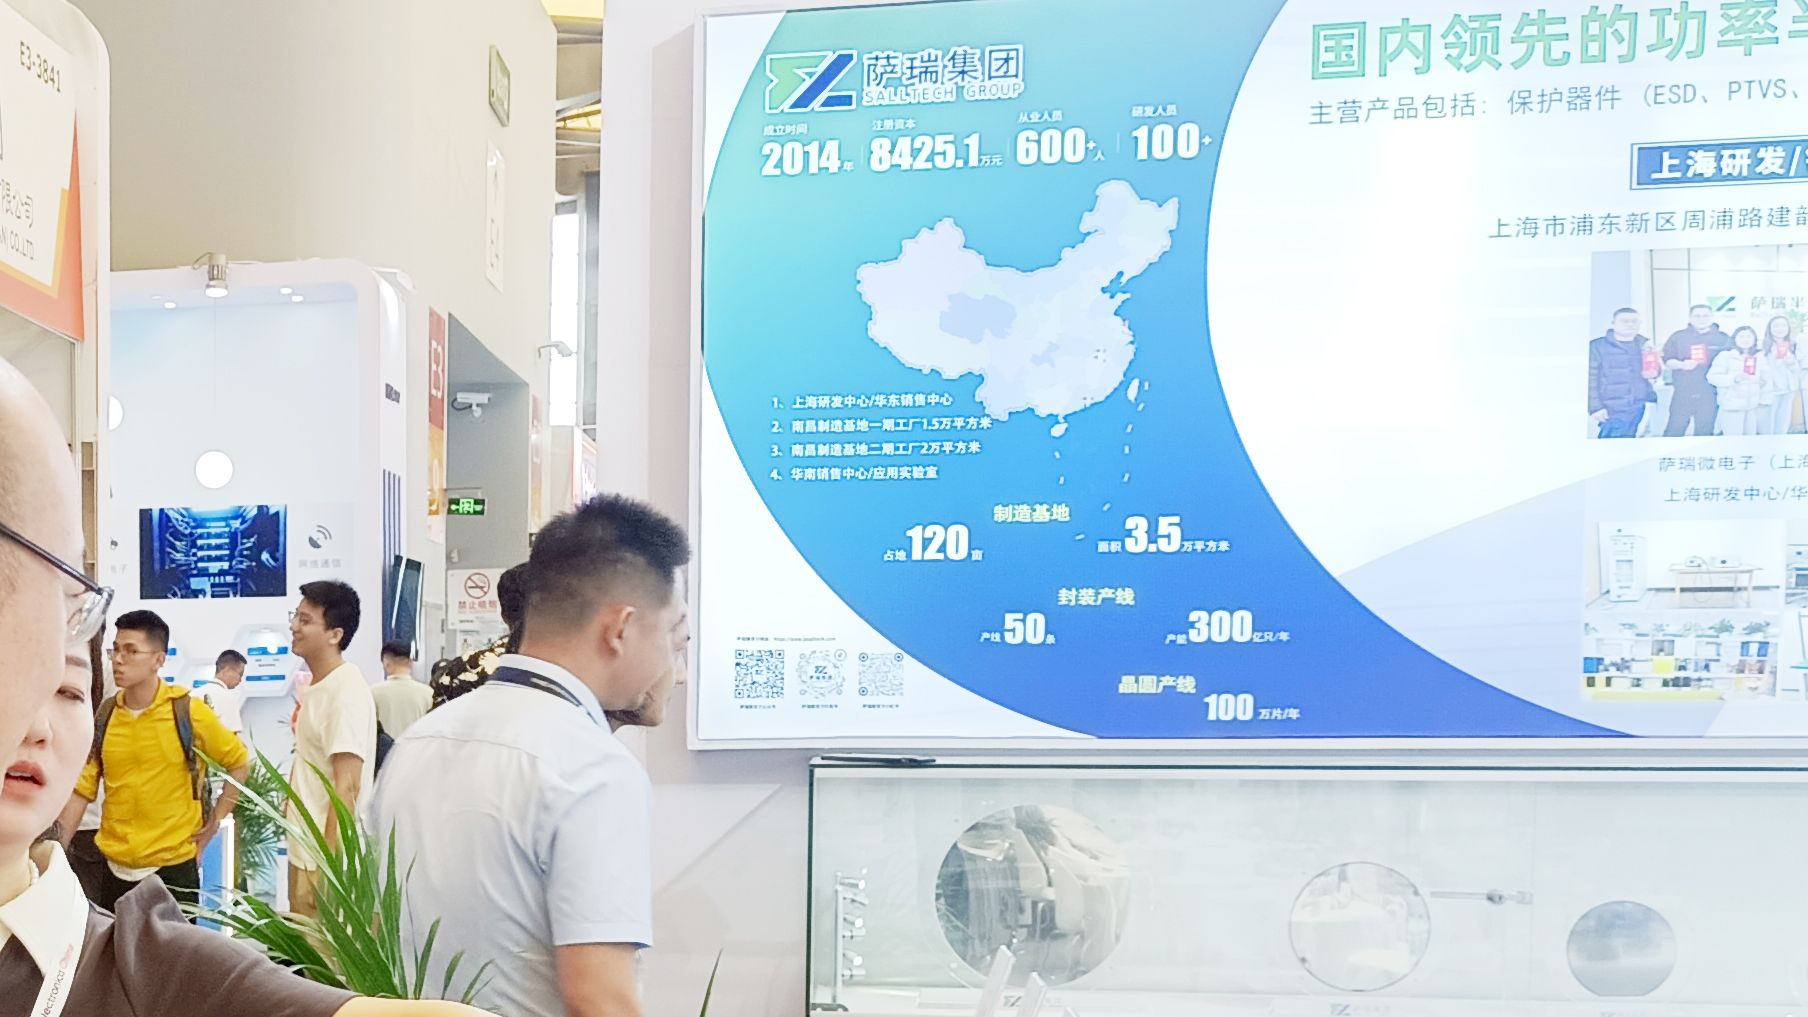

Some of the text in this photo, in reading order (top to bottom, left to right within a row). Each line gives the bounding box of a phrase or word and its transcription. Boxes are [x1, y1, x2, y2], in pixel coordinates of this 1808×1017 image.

[19, 40, 61, 94] E3-3841
[864, 46, 1021, 88] 萨瑞集团
[865, 82, 1023, 104] SALLTECH GROUP
[763, 124, 808, 136] 成立时间
[1018, 110, 1063, 123] 从业人员
[1131, 104, 1177, 117] 研发人员
[993, 503, 1071, 523] 制造基地
[1057, 587, 1135, 606] 封装产线
[1118, 675, 1197, 694] 晶圆产线
